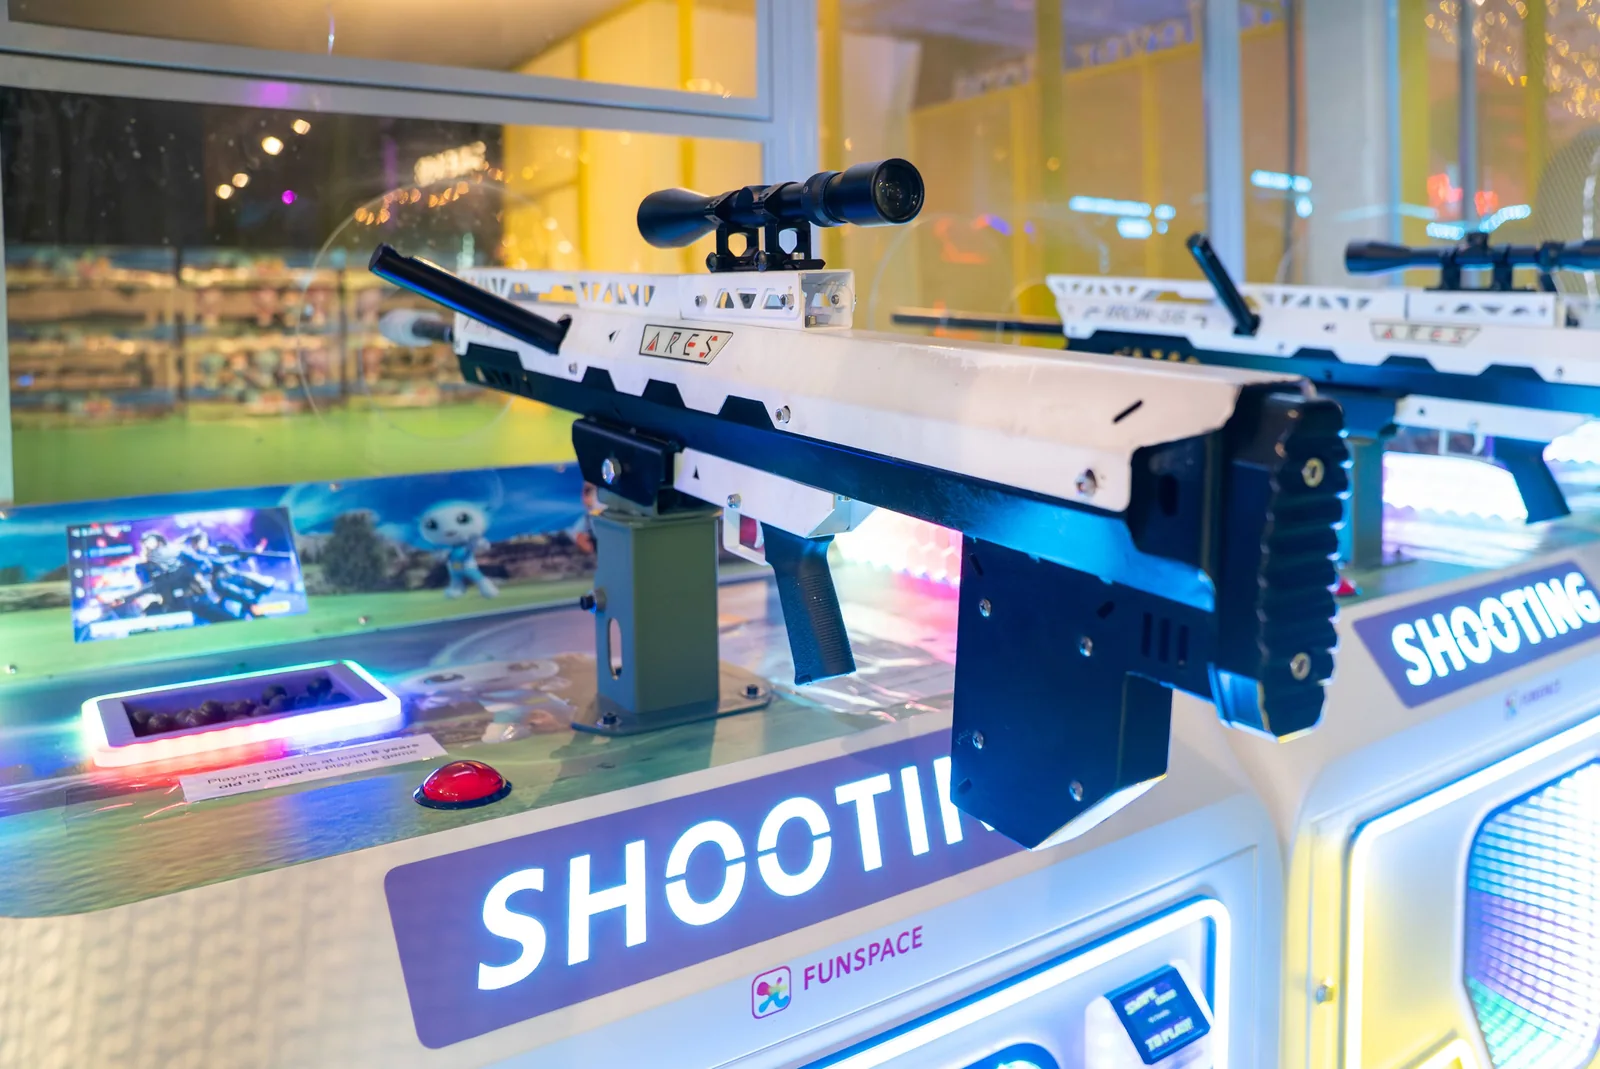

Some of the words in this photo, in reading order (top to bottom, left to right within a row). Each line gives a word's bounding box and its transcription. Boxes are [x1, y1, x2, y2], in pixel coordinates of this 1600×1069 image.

[644, 331, 719, 359] ARES
[1391, 571, 1600, 686] SHOOTING
[208, 771, 260, 785] Players
[264, 764, 296, 774] must
[383, 743, 420, 753] years
[219, 781, 243, 790] old
[267, 769, 304, 781] older
[478, 755, 995, 991] SHOOTI
[803, 925, 923, 991] FUNSPACE
